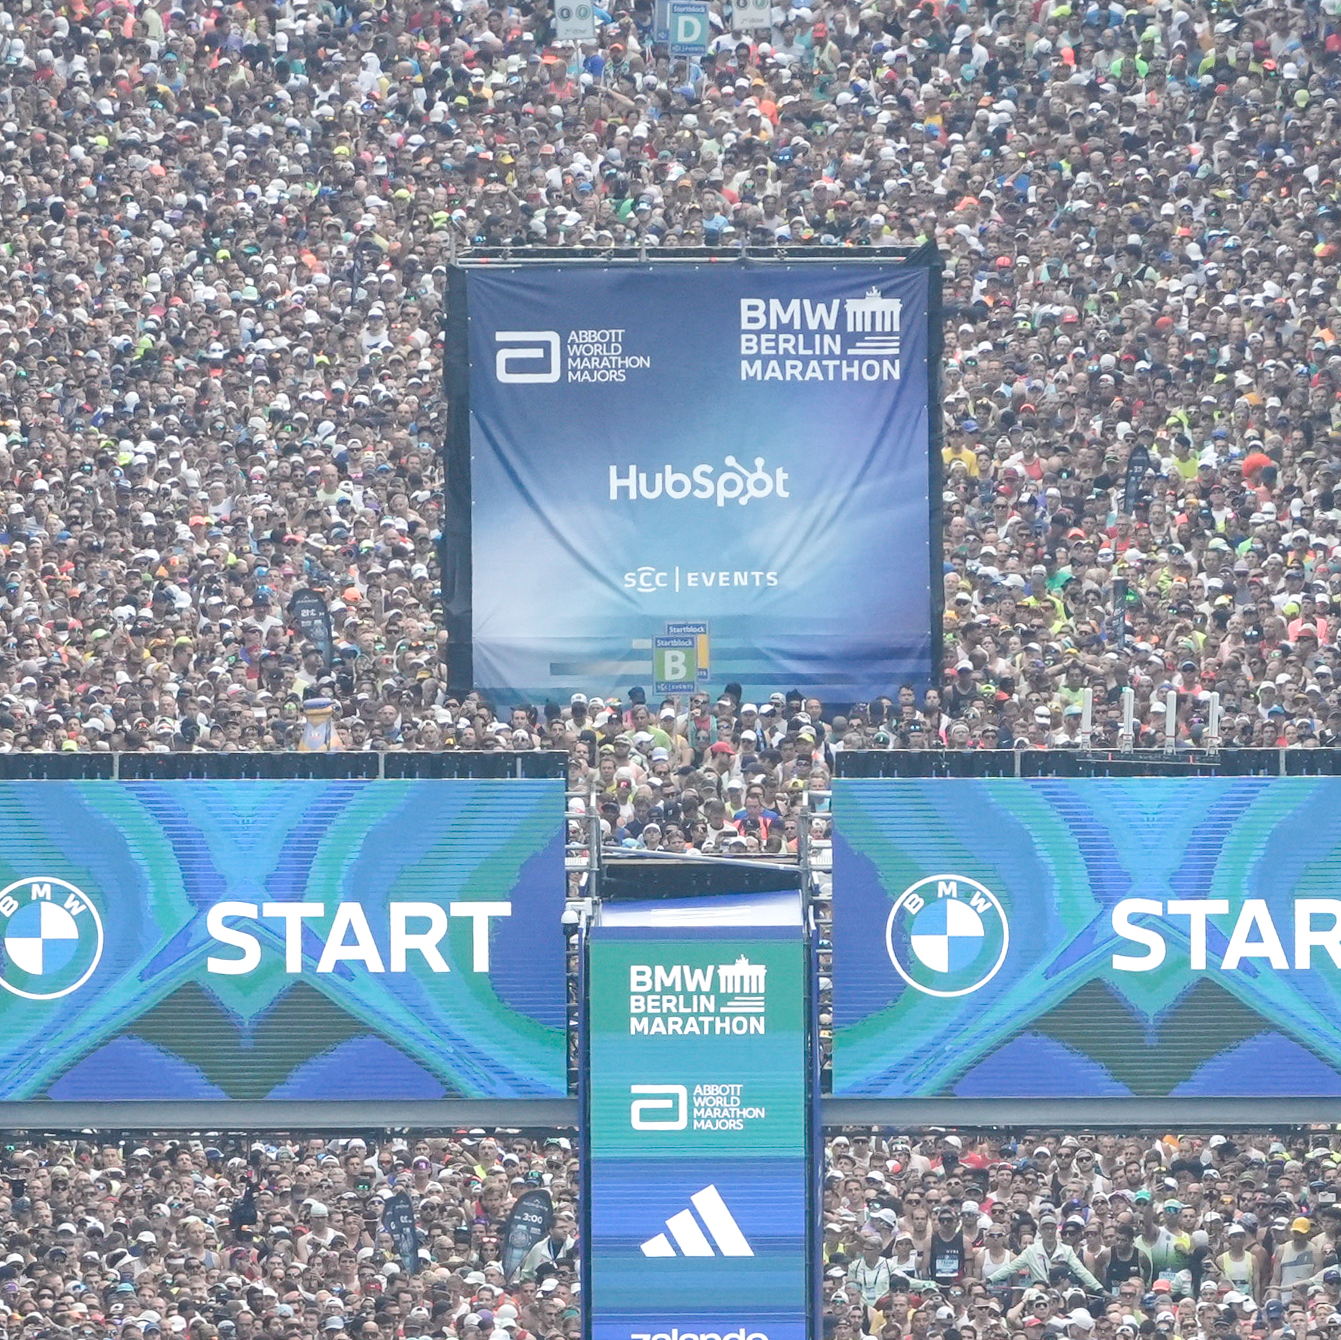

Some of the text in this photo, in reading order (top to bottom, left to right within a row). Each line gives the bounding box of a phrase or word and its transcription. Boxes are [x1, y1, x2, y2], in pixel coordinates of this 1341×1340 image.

[678, 15, 701, 43] D
[741, 298, 840, 330] BMW
[567, 329, 625, 342] ABBOTT
[741, 334, 841, 355] BERLIN
[567, 343, 622, 356] WORLD
[567, 355, 651, 369] MARATHON
[741, 359, 900, 381] MARATHON
[567, 369, 627, 383] MAJORS
[609, 455, 790, 507] HubSpot
[624, 566, 779, 593] SCC EVENTS
[669, 624, 706, 634] Startblock
[656, 639, 693, 648] Startblock
[664, 649, 687, 680] B
[902, 879, 993, 915] BMW
[207, 901, 512, 975] START
[630, 965, 715, 992] BMW
[630, 995, 716, 1013] BERLIN
[630, 1016, 766, 1035] MARATHON
[693, 1085, 744, 1097] ABBOTT
[693, 1097, 741, 1108] WORLD
[693, 1109, 766, 1120] MARATHON
[693, 1120, 744, 1131] MAJORS
